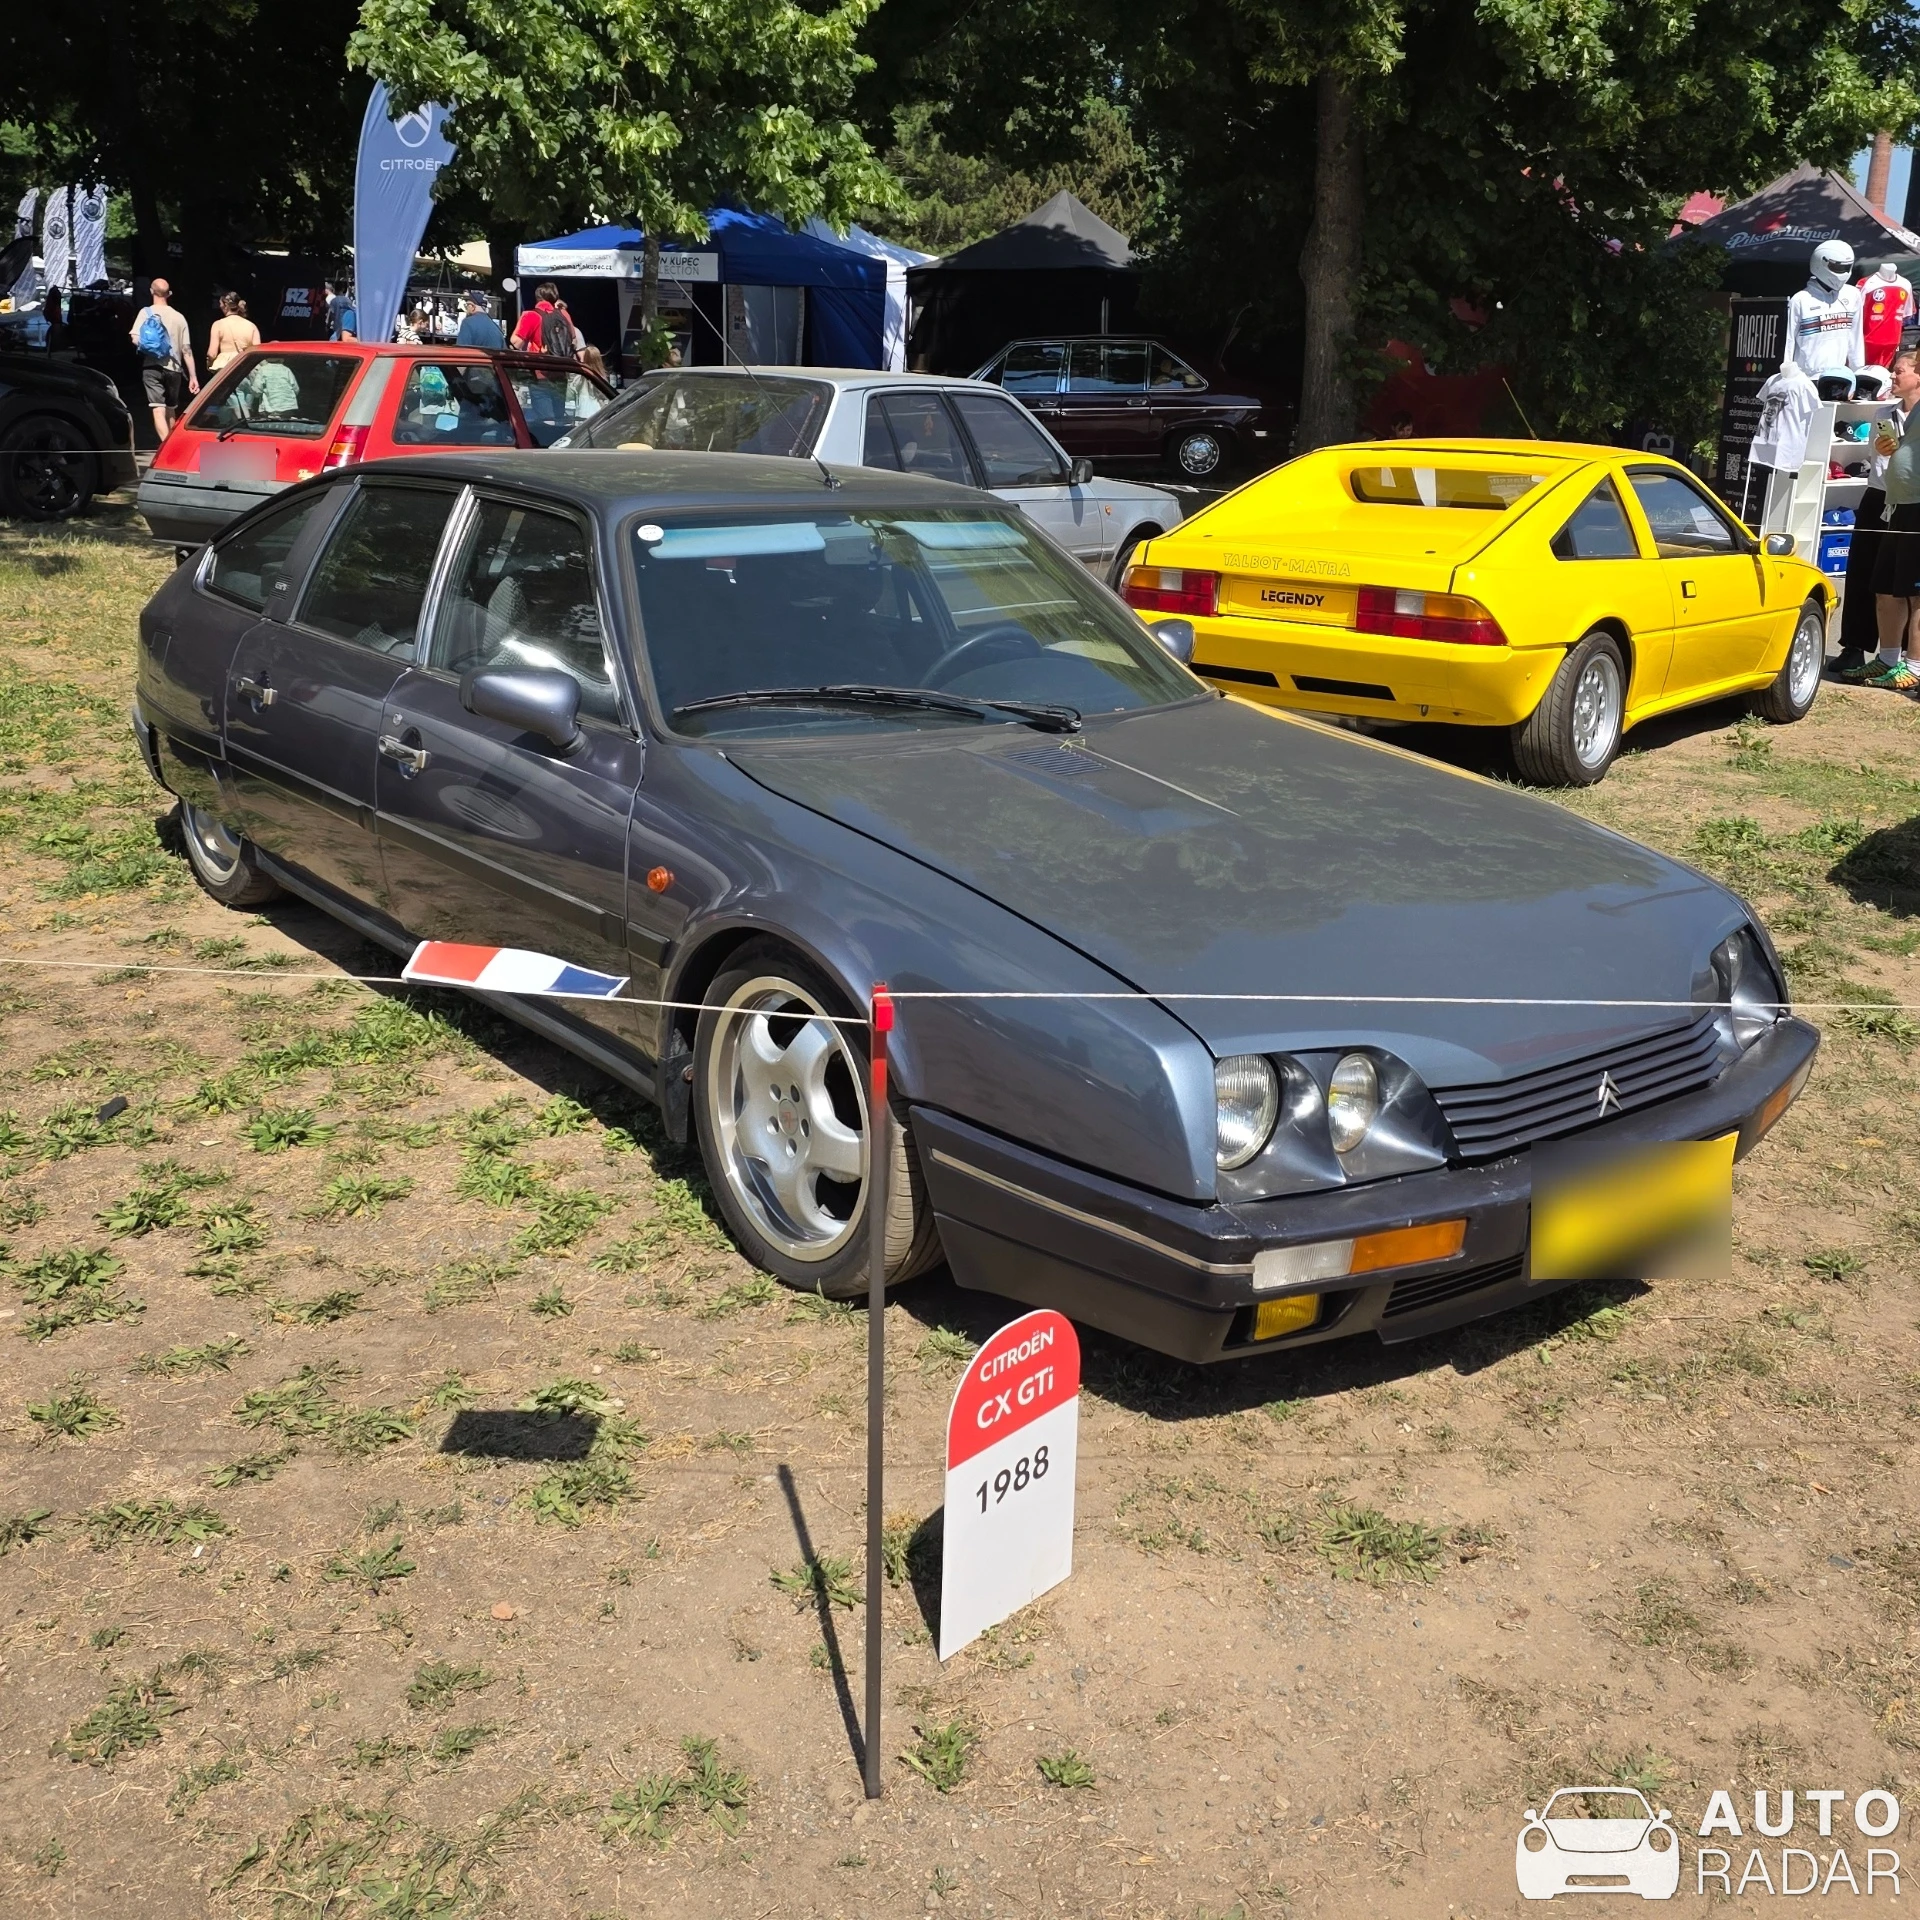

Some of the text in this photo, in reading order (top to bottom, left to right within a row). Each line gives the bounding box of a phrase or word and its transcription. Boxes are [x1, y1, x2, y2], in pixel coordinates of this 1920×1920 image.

[1725, 224, 1840, 249] Pilsner Urquell
[633, 255, 700, 266] MAN KUPEC
[658, 265, 700, 275] LECTION
[1736, 314, 1779, 358] RACELIFE
[1820, 322, 1847, 332] RACING
[1223, 553, 1351, 577] TALBOT-MATRA
[1261, 589, 1325, 607] LEGENDY
[980, 1326, 1054, 1382] CITROËN
[977, 1366, 1054, 1428] CX GTi
[976, 1445, 1050, 1514] 1988
